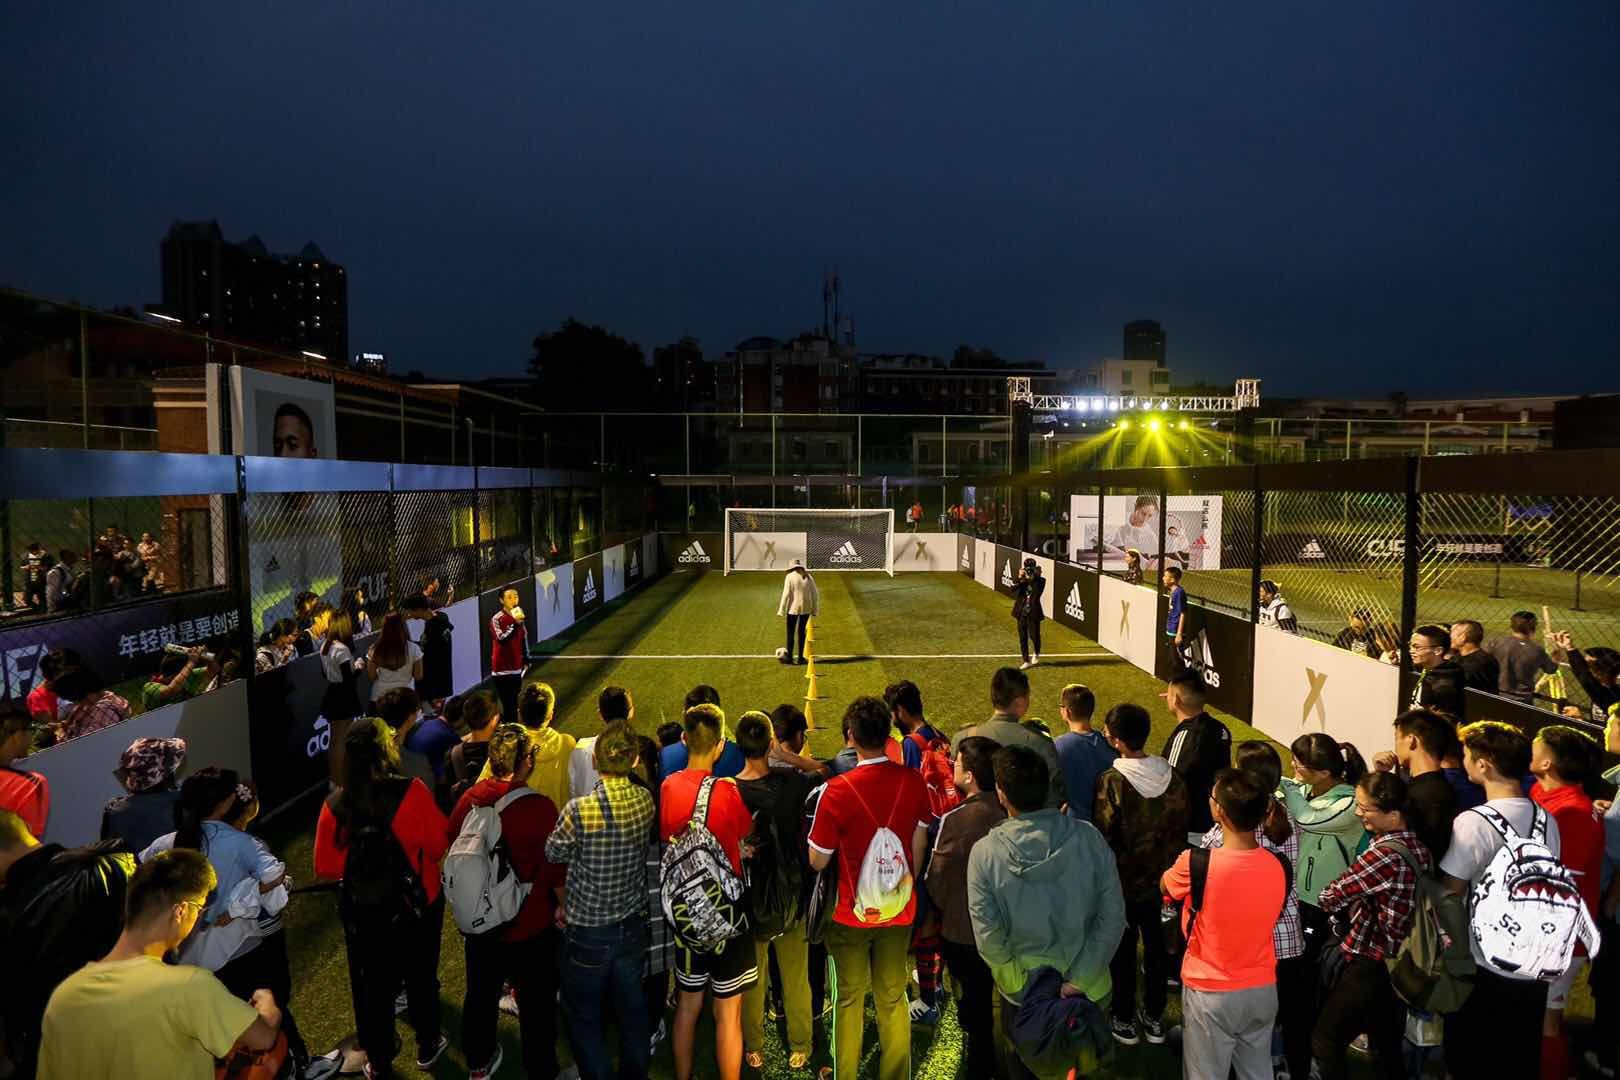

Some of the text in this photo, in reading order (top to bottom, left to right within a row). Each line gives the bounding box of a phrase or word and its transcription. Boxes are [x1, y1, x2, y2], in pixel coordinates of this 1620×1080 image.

[678, 554, 711, 563] adidas
[1064, 603, 1085, 622] adidas
[1499, 913, 1521, 937] 52
